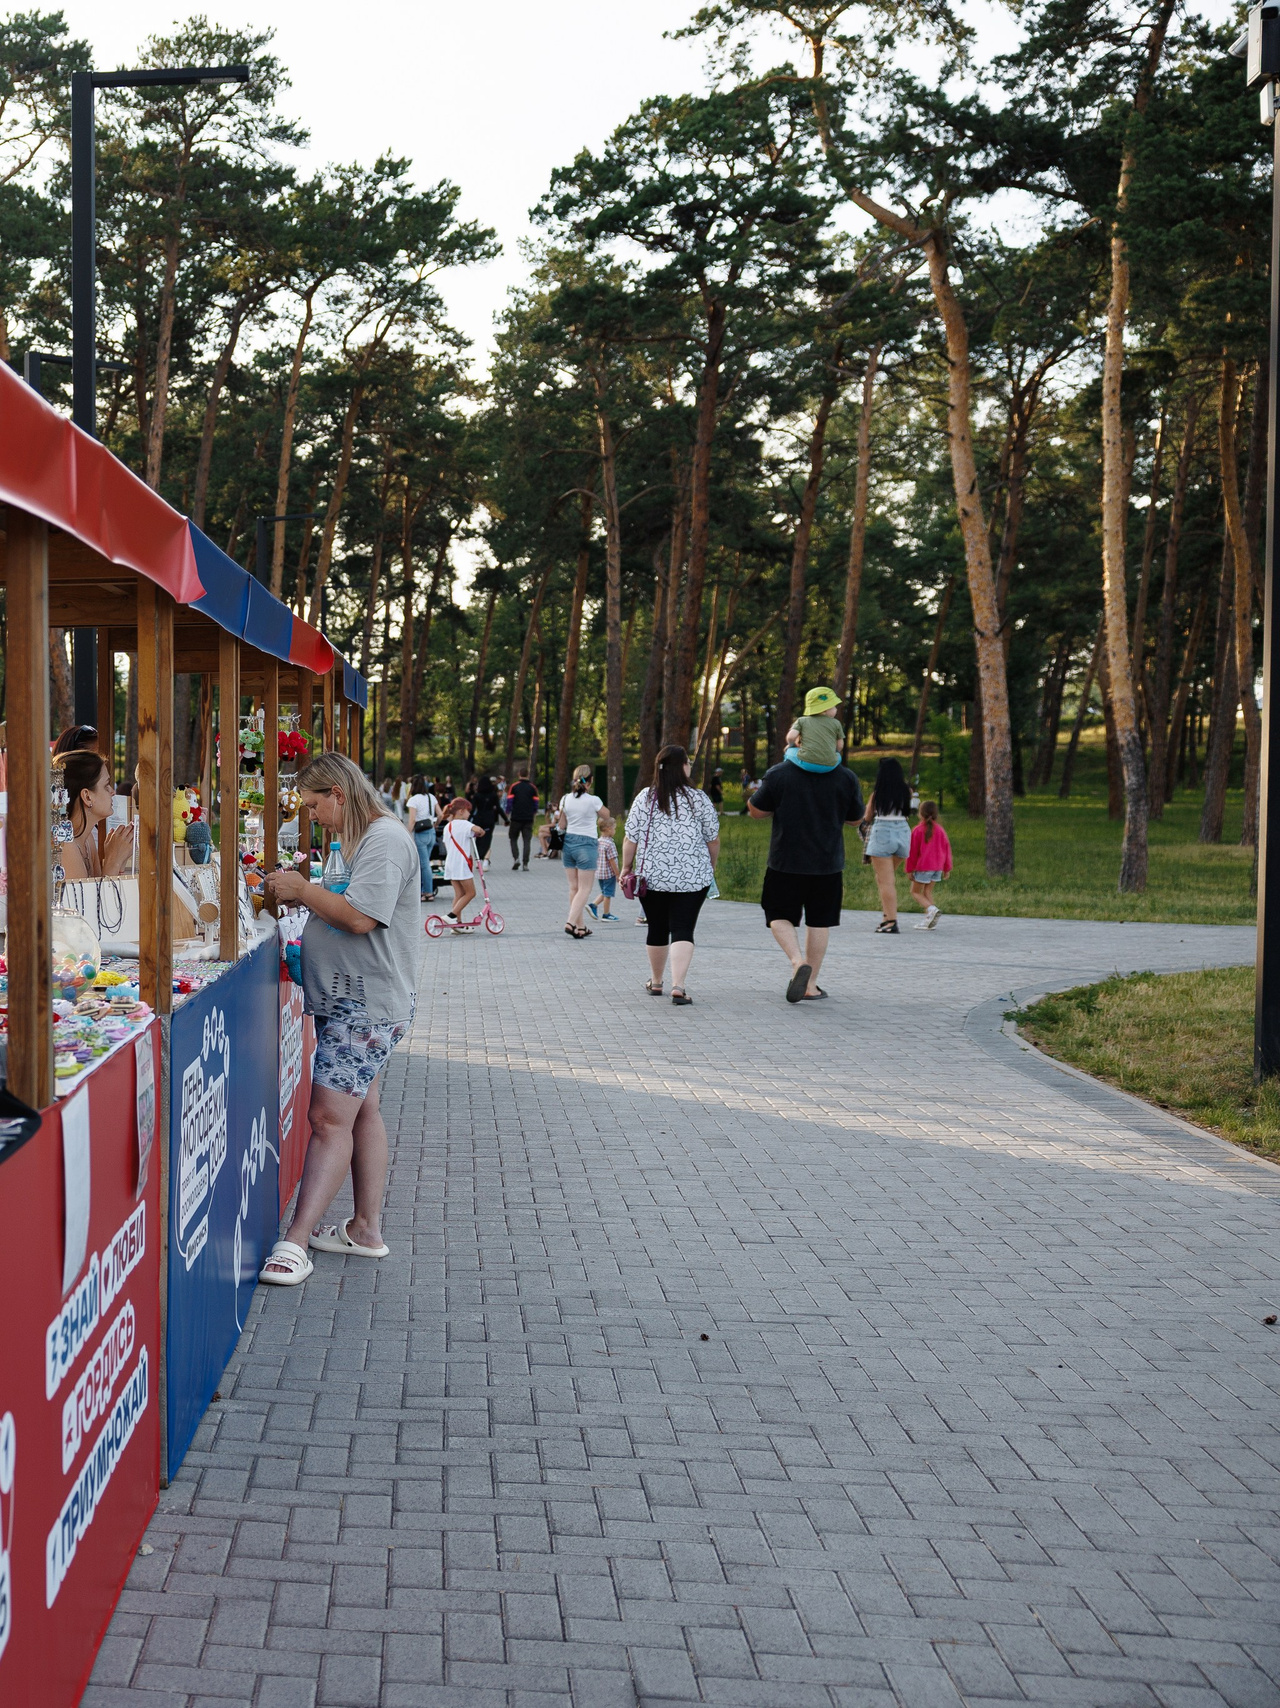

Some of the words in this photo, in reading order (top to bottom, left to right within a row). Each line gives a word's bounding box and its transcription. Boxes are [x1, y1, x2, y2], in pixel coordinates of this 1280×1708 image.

[183, 1066, 202, 1128] ДЕНЬ
[211, 1118, 226, 1176] 2025
[61, 1264, 99, 1366] ЗНАЙ
[112, 1209, 144, 1291] ЛЮБИ
[76, 1309, 133, 1439] ГОРДИСЬ
[61, 1356, 147, 1565] ПРИУМНОЖАЙ
